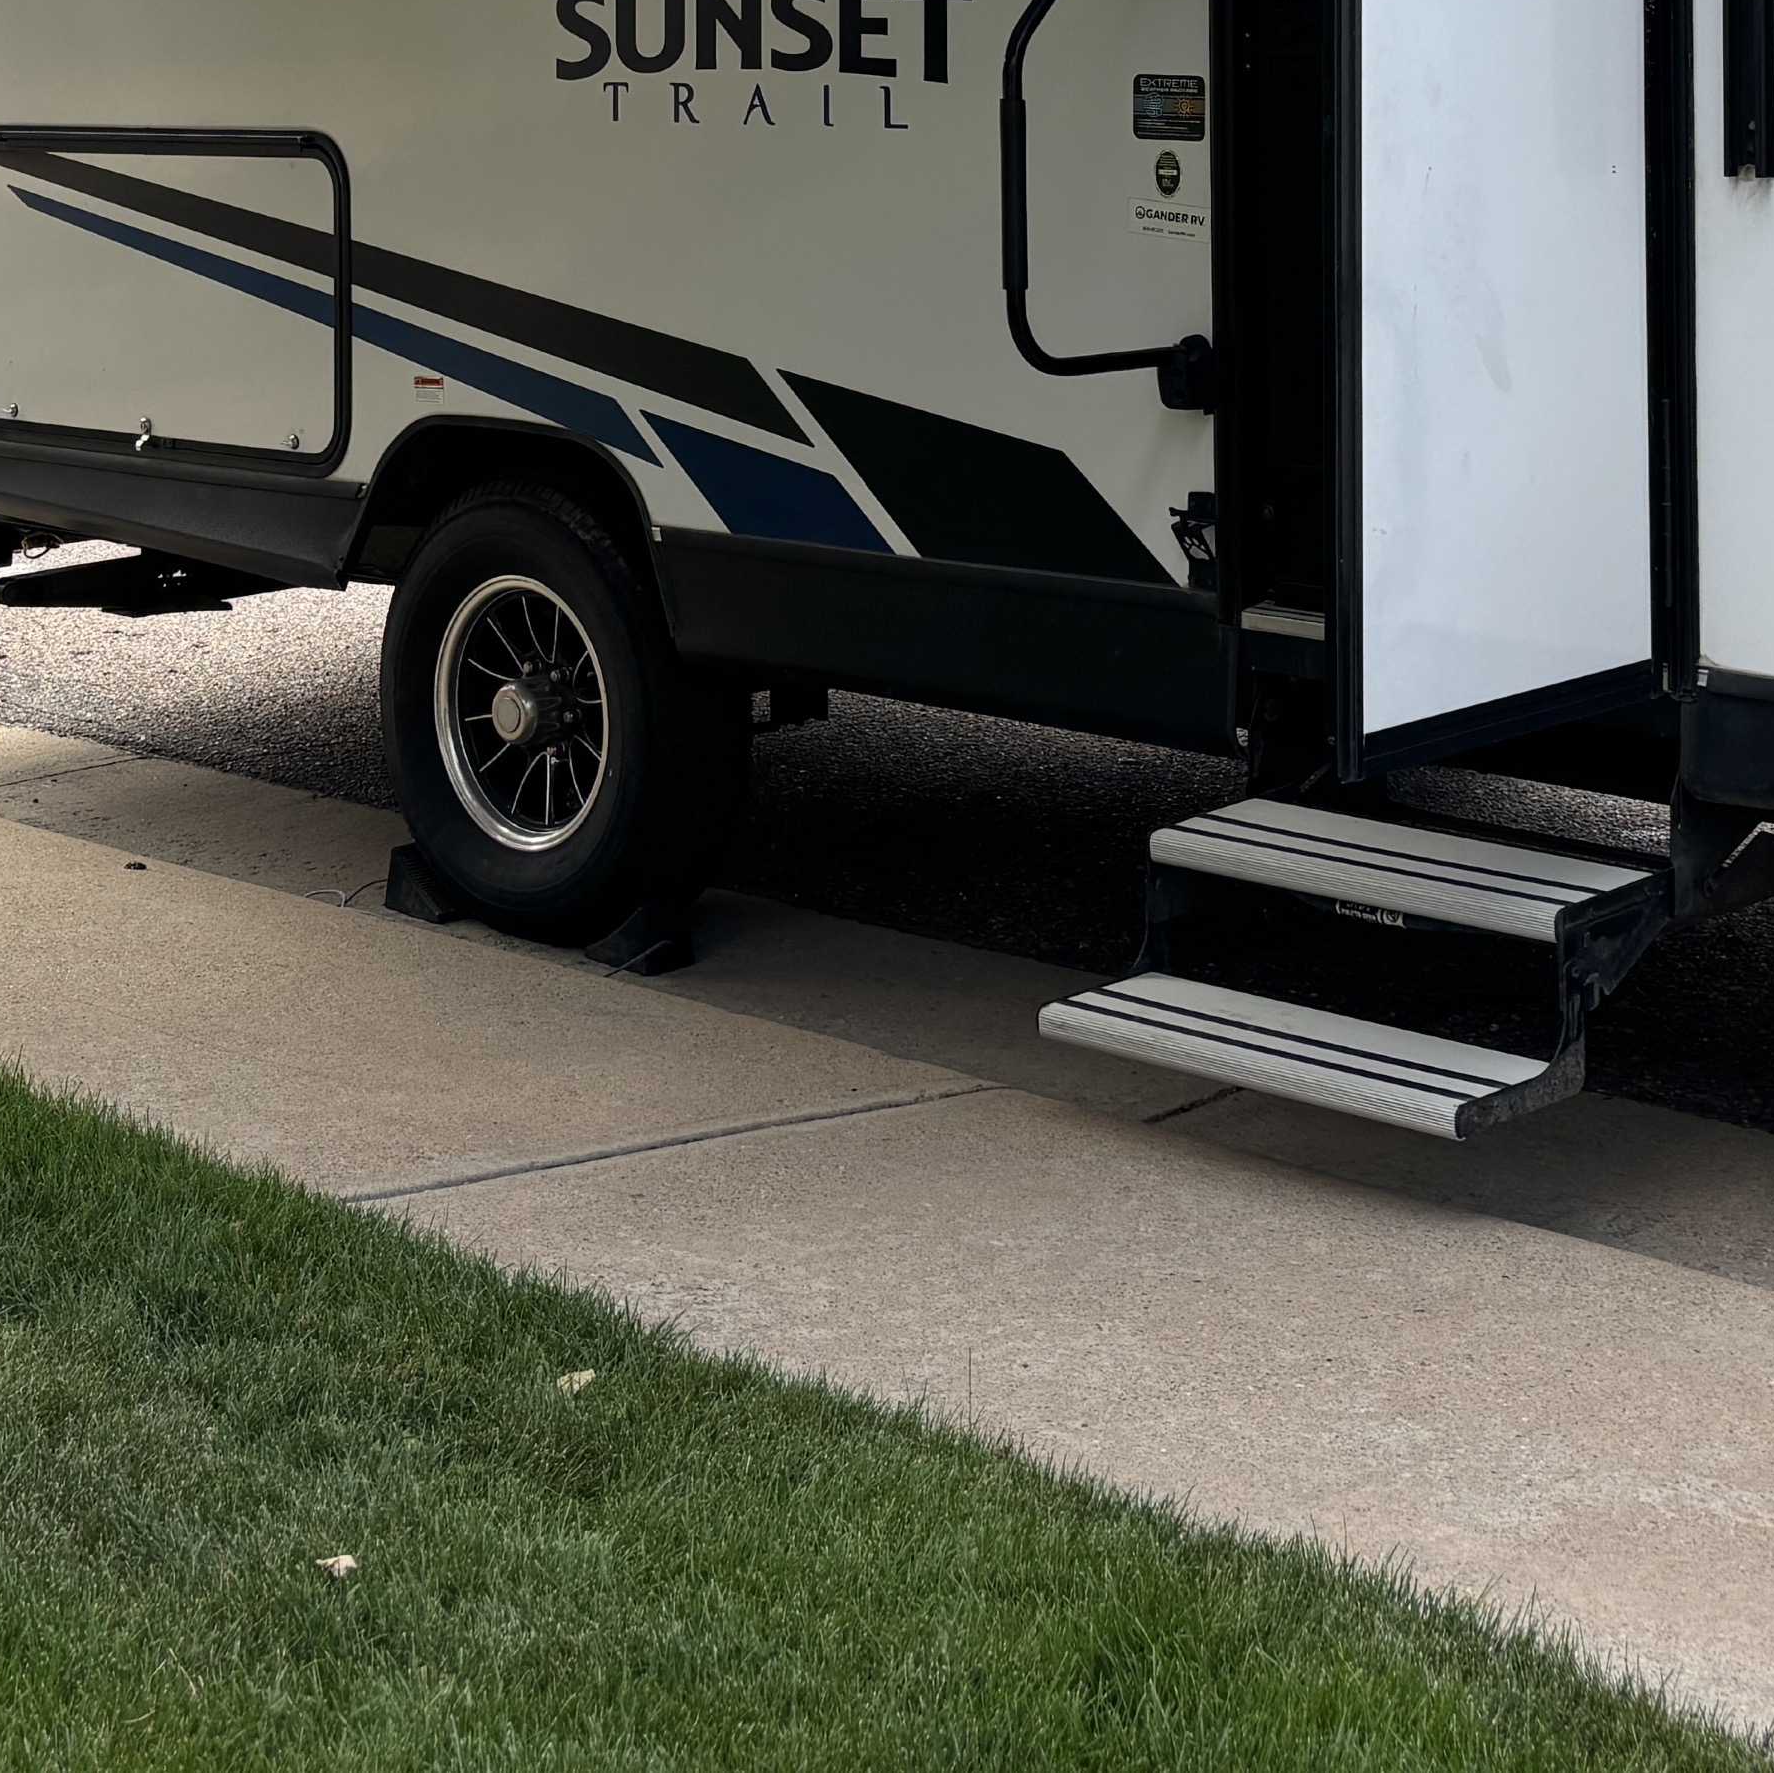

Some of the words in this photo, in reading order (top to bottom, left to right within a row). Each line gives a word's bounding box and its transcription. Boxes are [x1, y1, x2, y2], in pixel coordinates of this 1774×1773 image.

[1139, 77, 1198, 88] EXTREME
[603, 81, 909, 129] TRAIL
[1146, 208, 1189, 224] GANDER
[1190, 215, 1206, 226] RV
